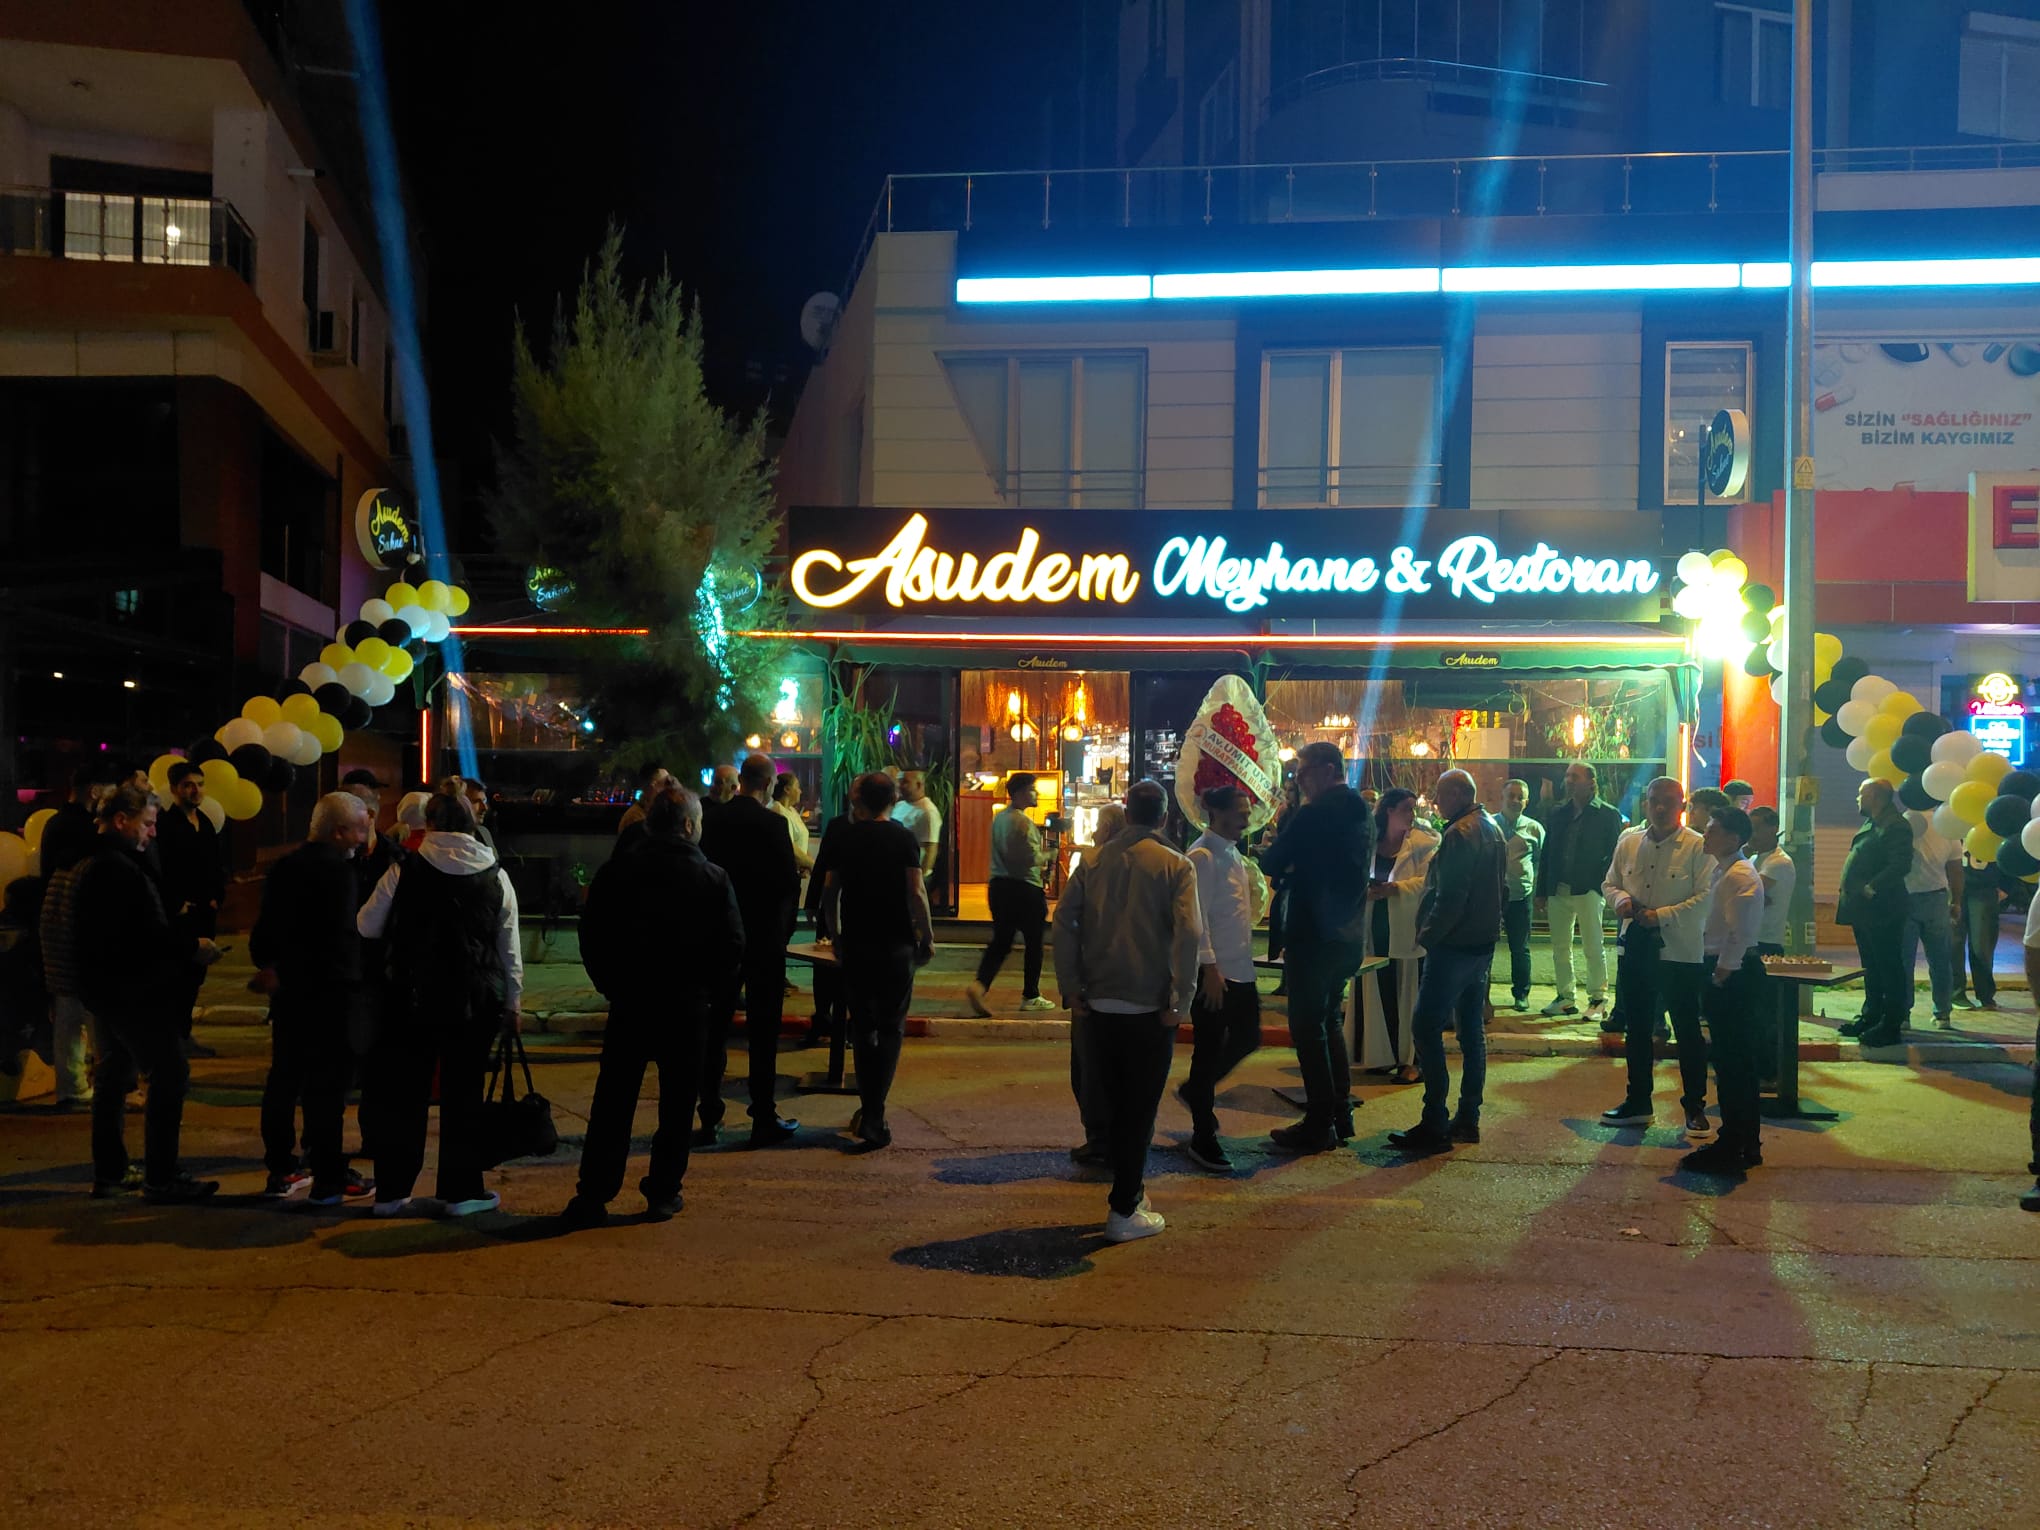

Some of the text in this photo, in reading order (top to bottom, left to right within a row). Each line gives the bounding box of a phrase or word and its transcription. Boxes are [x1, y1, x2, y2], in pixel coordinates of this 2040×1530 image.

[1844, 411, 1896, 427] SİZİN
[1861, 430, 2015, 445] BİZİM KAYGIMIZ
[377, 531, 404, 555] Sahne
[790, 512, 1659, 612] Asudem Meyhane & Restoran
[1017, 655, 1069, 669] Asudem
[1445, 652, 1499, 666] Asudem
